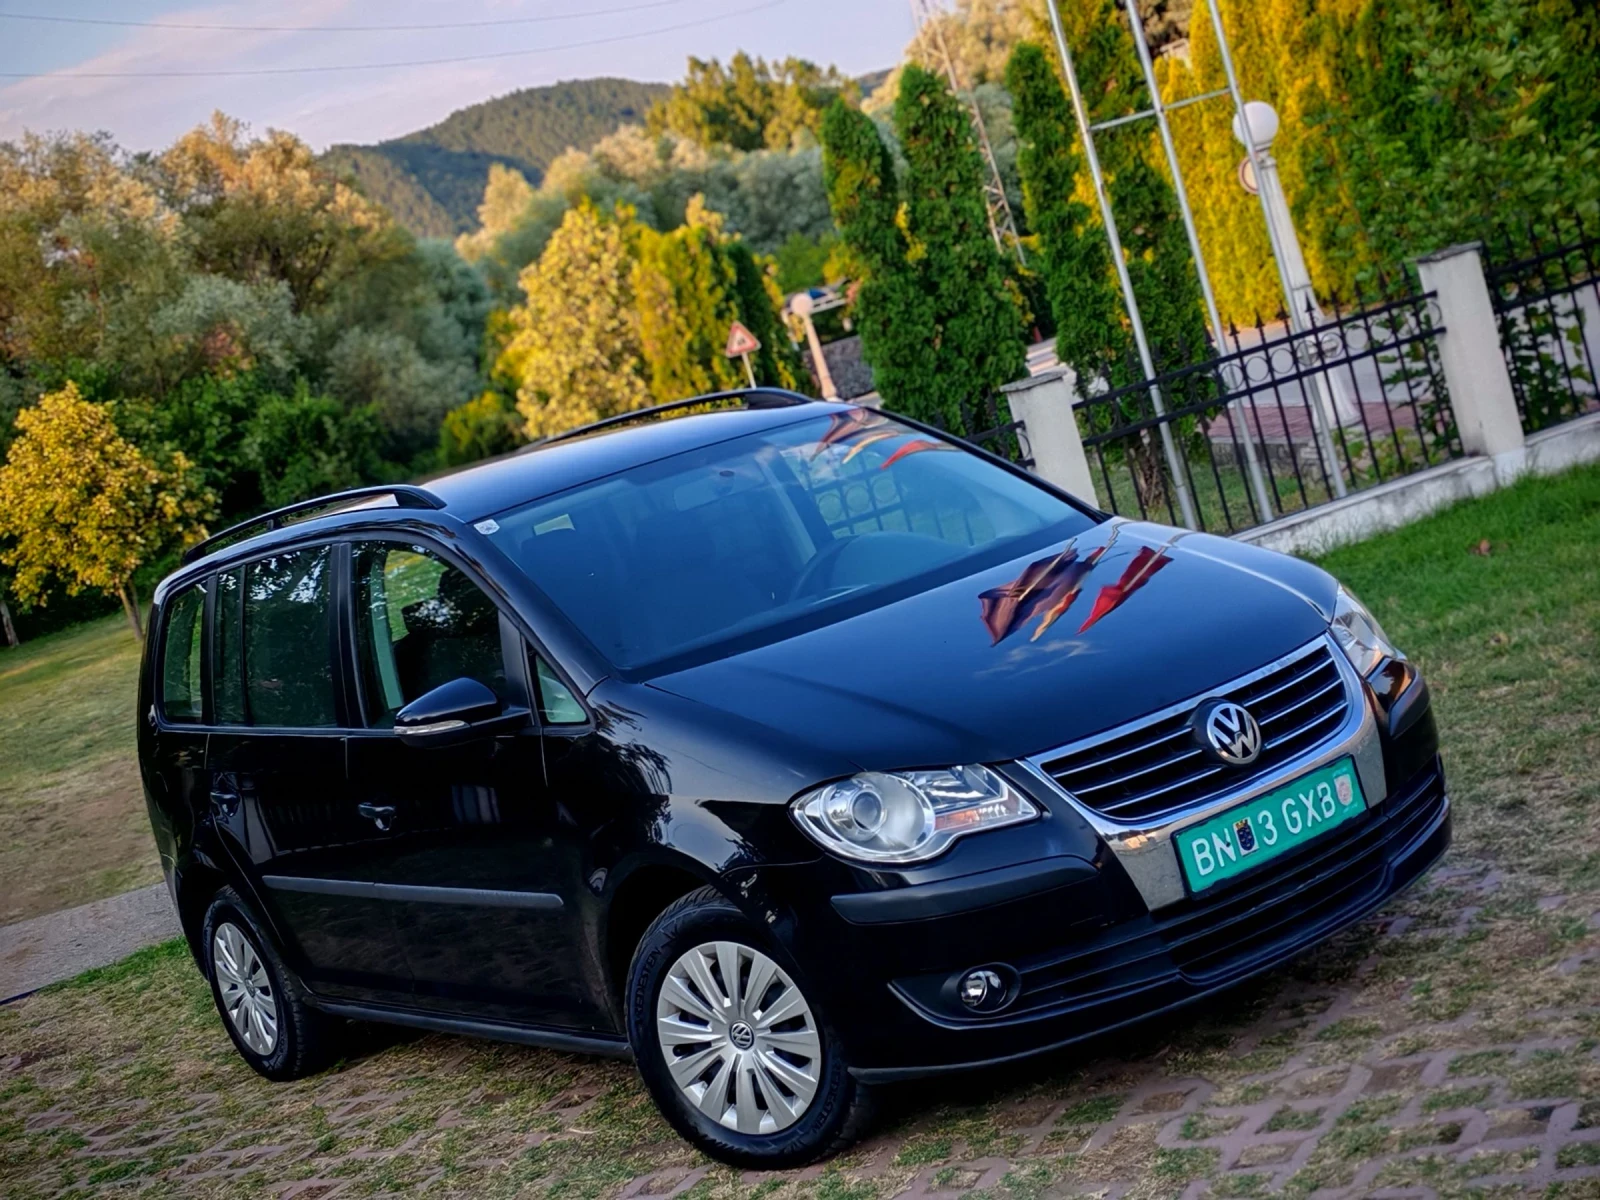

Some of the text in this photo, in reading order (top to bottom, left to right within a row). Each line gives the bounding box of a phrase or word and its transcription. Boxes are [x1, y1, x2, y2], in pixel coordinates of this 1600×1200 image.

[1207, 703, 1262, 764] VW
[1191, 782, 1336, 876] BN 3 GXB
